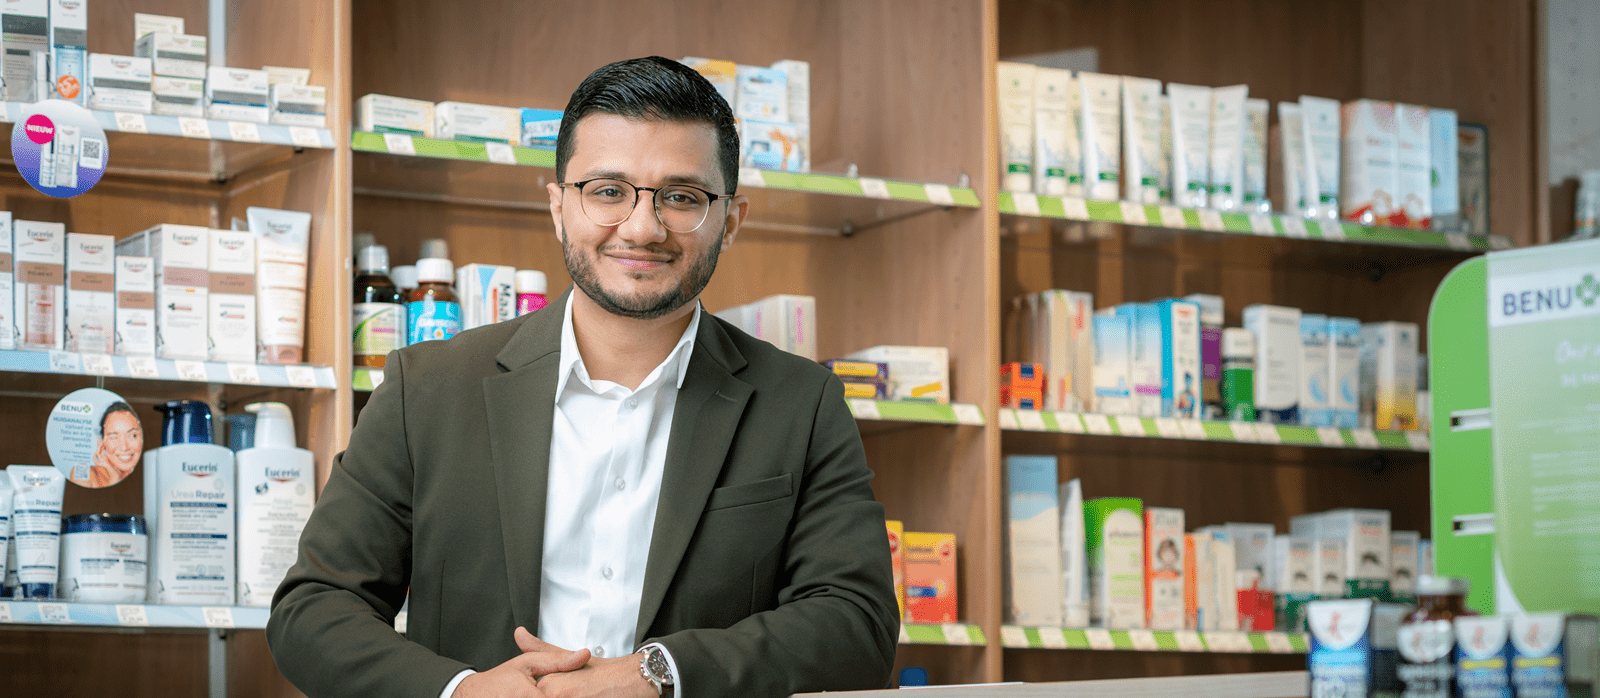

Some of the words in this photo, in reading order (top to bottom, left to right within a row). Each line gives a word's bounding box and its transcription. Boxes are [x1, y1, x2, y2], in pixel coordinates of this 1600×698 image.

[26, 124, 54, 134] NIEUW
[27, 229, 55, 238] Eucerin
[1503, 287, 1572, 316] BENU
[61, 404, 83, 413] BENU
[182, 462, 218, 472] Eucerin
[265, 467, 300, 477] Eucerin
[195, 490, 225, 500] Repair
[35, 499, 60, 507] Repair
